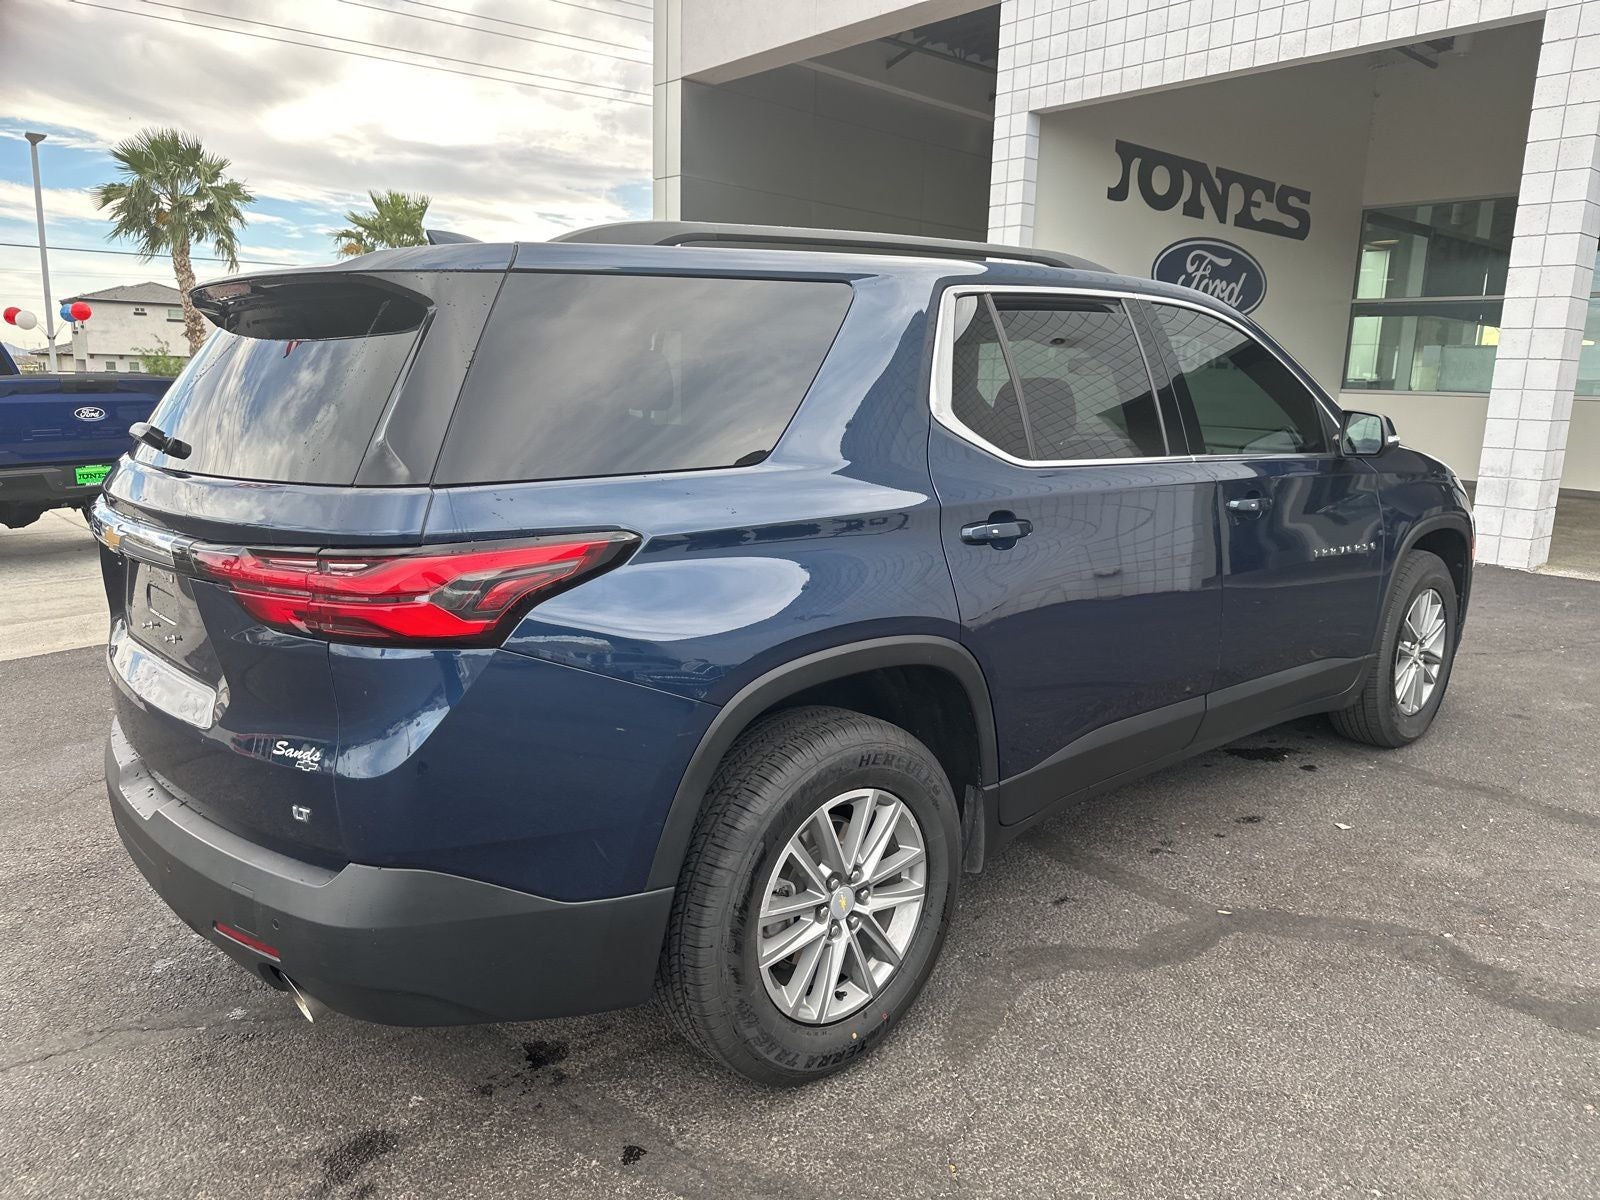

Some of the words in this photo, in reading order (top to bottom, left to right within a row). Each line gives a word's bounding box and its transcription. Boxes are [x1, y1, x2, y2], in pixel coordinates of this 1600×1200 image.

[1107, 139, 1311, 241] JONES
[1176, 250, 1248, 307] Ford
[273, 740, 321, 761] Sands
[292, 805, 311, 822] LT
